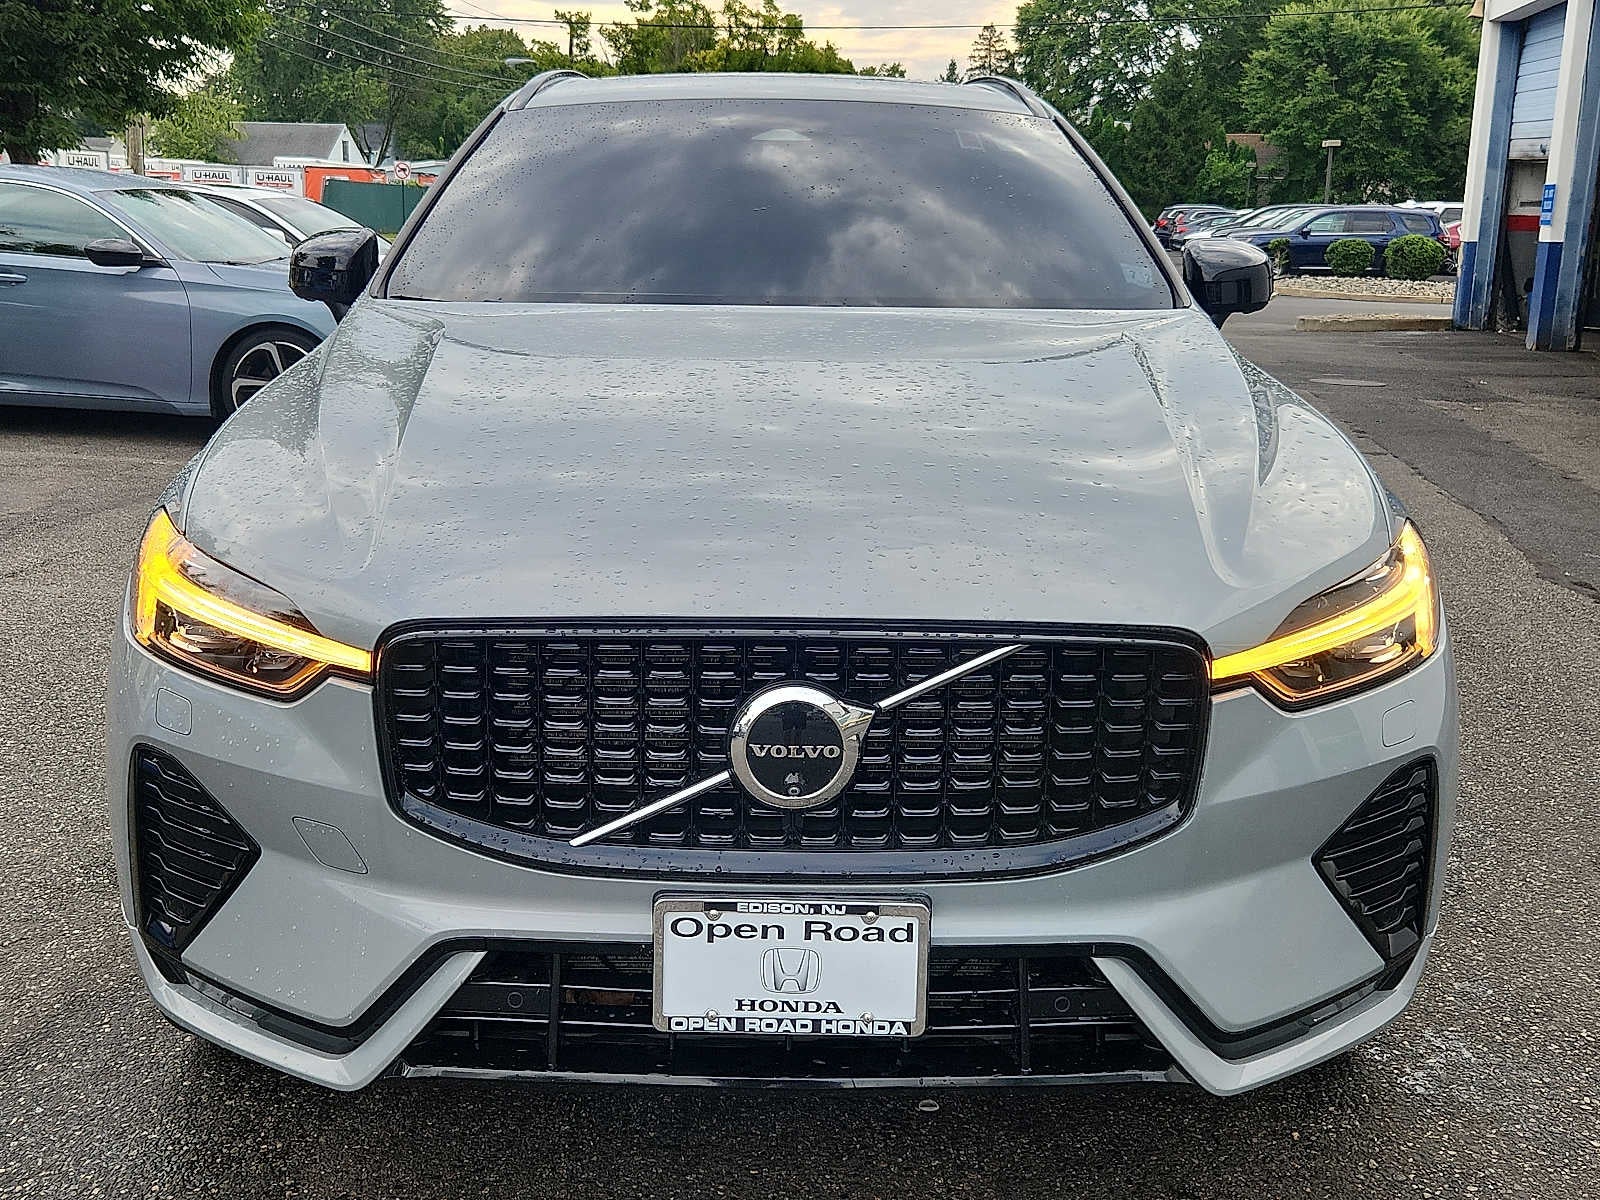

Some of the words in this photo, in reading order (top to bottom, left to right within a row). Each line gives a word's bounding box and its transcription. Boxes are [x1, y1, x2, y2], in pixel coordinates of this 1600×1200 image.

[193, 171, 231, 180] U-HAUL
[256, 173, 293, 183] U-HAUL
[749, 743, 840, 758] VOLVO
[821, 905, 847, 915] NJ
[670, 917, 785, 943] Open
[803, 920, 914, 943] Road
[734, 998, 844, 1014] HONDA
[670, 1017, 737, 1032] OPEN
[744, 1018, 813, 1033] ROAD
[820, 1019, 908, 1035] HONDA
